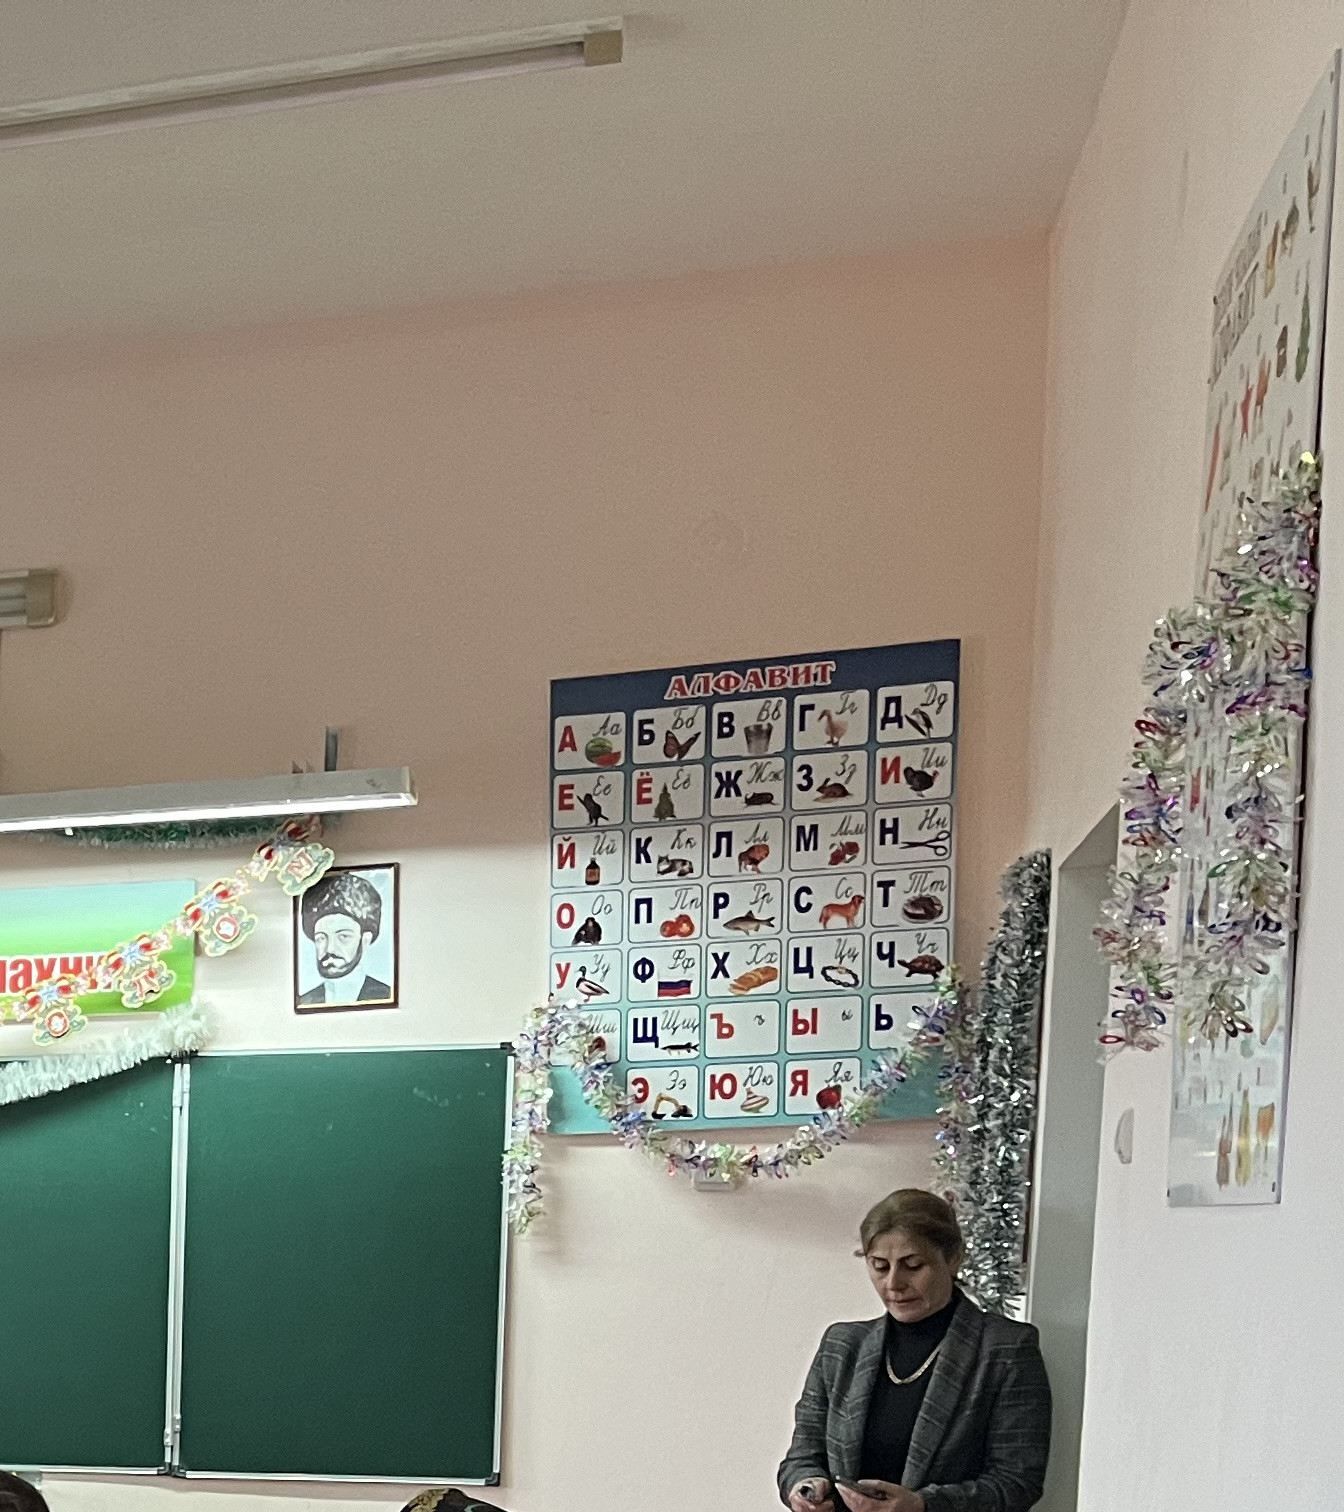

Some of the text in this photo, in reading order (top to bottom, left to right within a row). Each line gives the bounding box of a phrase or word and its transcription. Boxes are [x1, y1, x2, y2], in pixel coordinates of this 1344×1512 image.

[666, 662, 836, 699] АЛФАВИТ
[717, 712, 735, 739] В
[799, 704, 815, 731] Г
[880, 696, 903, 730] Д
[558, 726, 577, 753] А
[638, 718, 655, 746] Б
[796, 764, 813, 791] З
[881, 756, 900, 784] И
[558, 784, 575, 811] Е
[636, 771, 653, 806] Ё
[714, 770, 742, 799] Ж
[712, 831, 732, 858] Л
[796, 824, 818, 852] М
[880, 817, 899, 845] Н
[557, 836, 575, 869] Й
[635, 836, 652, 864] К
[713, 892, 729, 919] Р
[794, 886, 812, 913] С
[877, 880, 895, 907] Т
[556, 902, 575, 929] О
[635, 897, 652, 924] П
[711, 952, 730, 979] Х
[794, 946, 814, 978] Ц
[877, 941, 895, 968] Ч
[556, 962, 571, 989] У
[633, 957, 654, 983] Ф
[710, 1013, 734, 1040] Ъ
[792, 1008, 818, 1036] Ы
[875, 1004, 893, 1031] Ь
[633, 1016, 659, 1048] Щ
[631, 1077, 649, 1103] Э
[709, 1072, 737, 1100] Ю
[790, 1069, 808, 1097] Я
